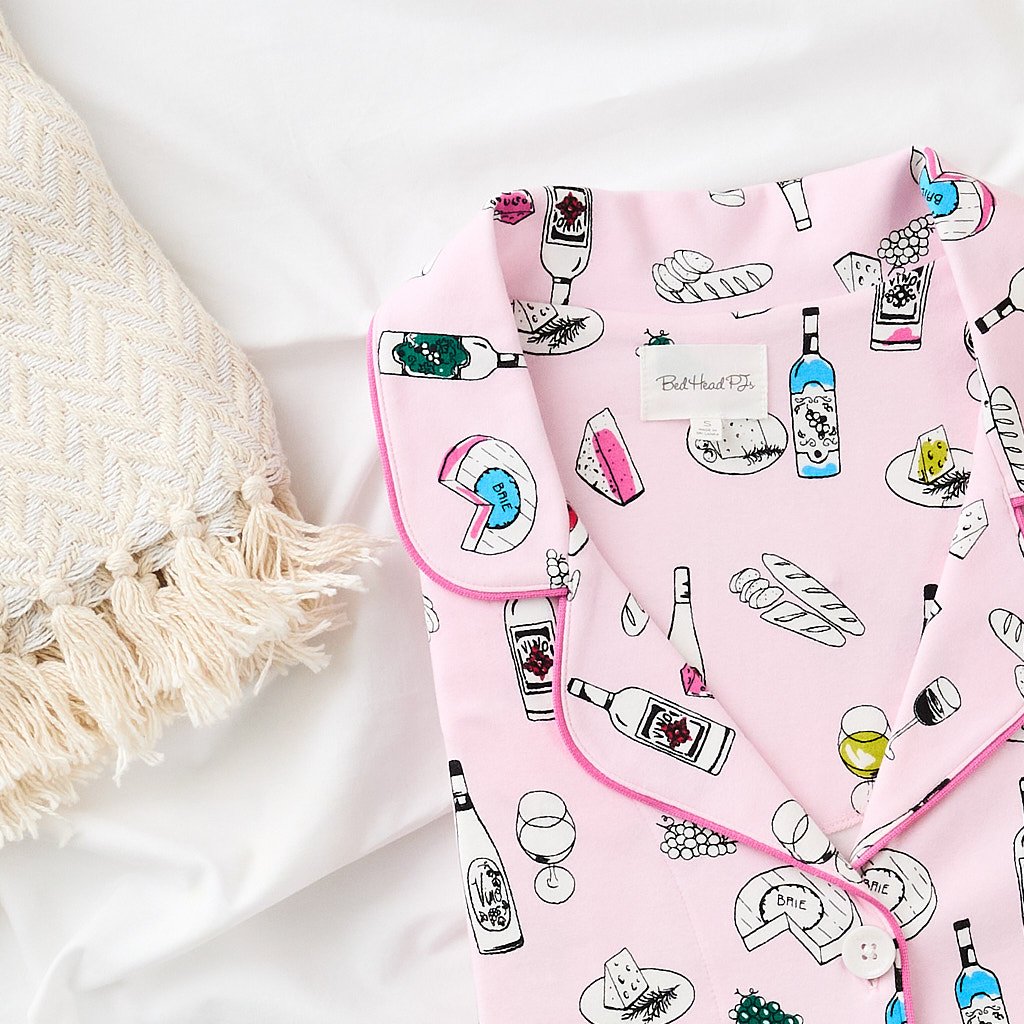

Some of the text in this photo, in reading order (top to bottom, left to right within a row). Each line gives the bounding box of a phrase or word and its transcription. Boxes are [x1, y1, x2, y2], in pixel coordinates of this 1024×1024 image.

[889, 272, 918, 287] VINO
[656, 373, 756, 392] Bed Head PJs
[492, 482, 513, 513] BRIE
[521, 637, 549, 654] VINO
[777, 894, 807, 911] BRIE
